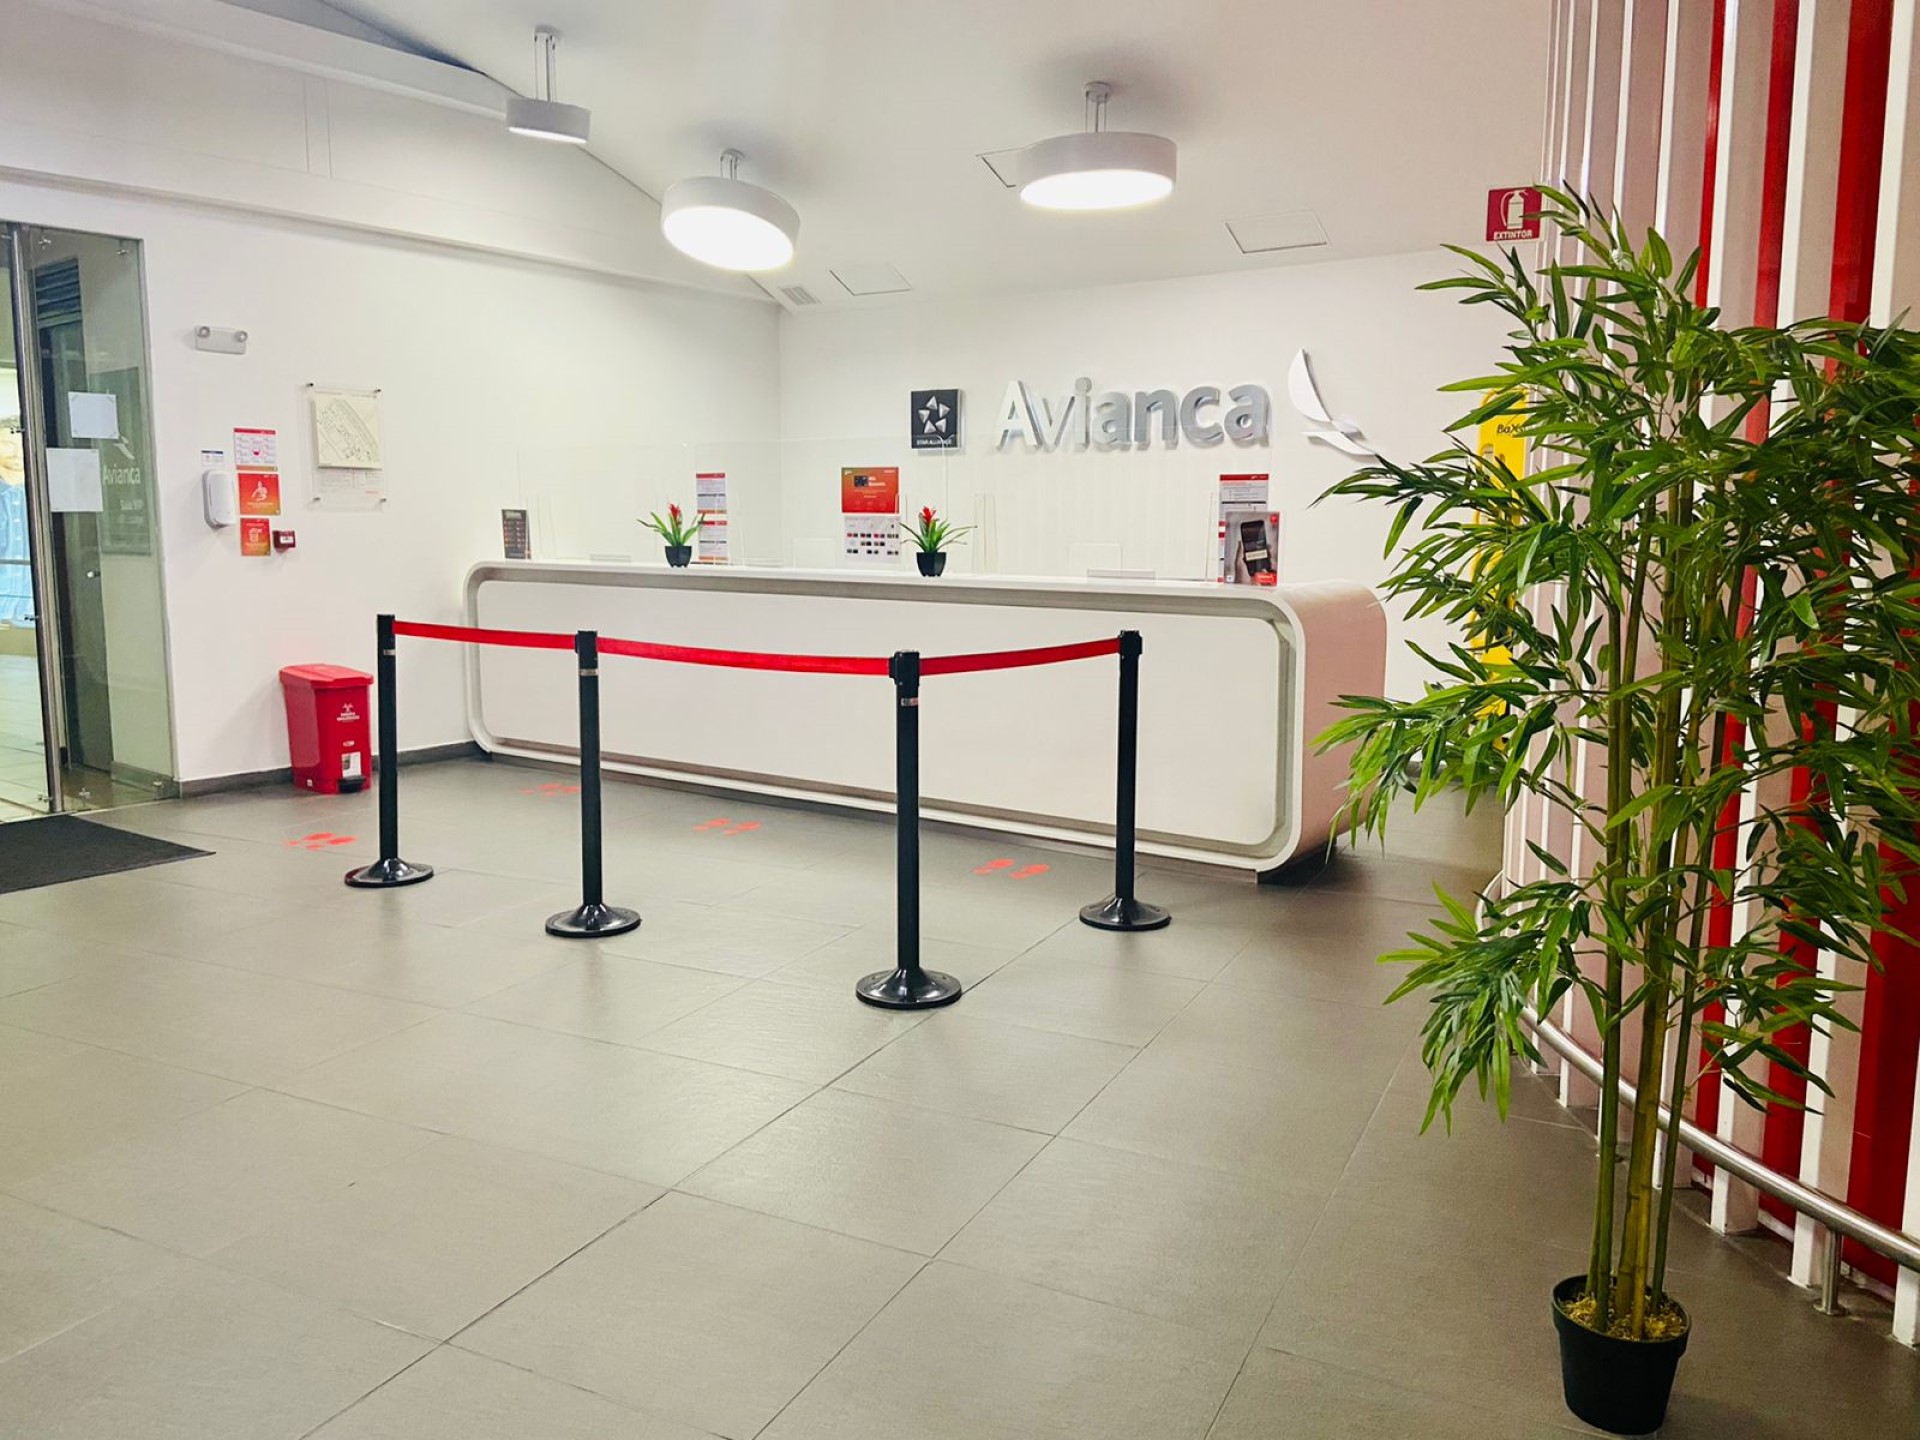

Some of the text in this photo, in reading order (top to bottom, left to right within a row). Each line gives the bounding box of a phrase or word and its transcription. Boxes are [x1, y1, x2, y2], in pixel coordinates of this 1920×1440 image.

[1493, 229, 1532, 241] EXTINTOR
[995, 376, 1273, 451] Avianca
[102, 463, 141, 486] Avianca
